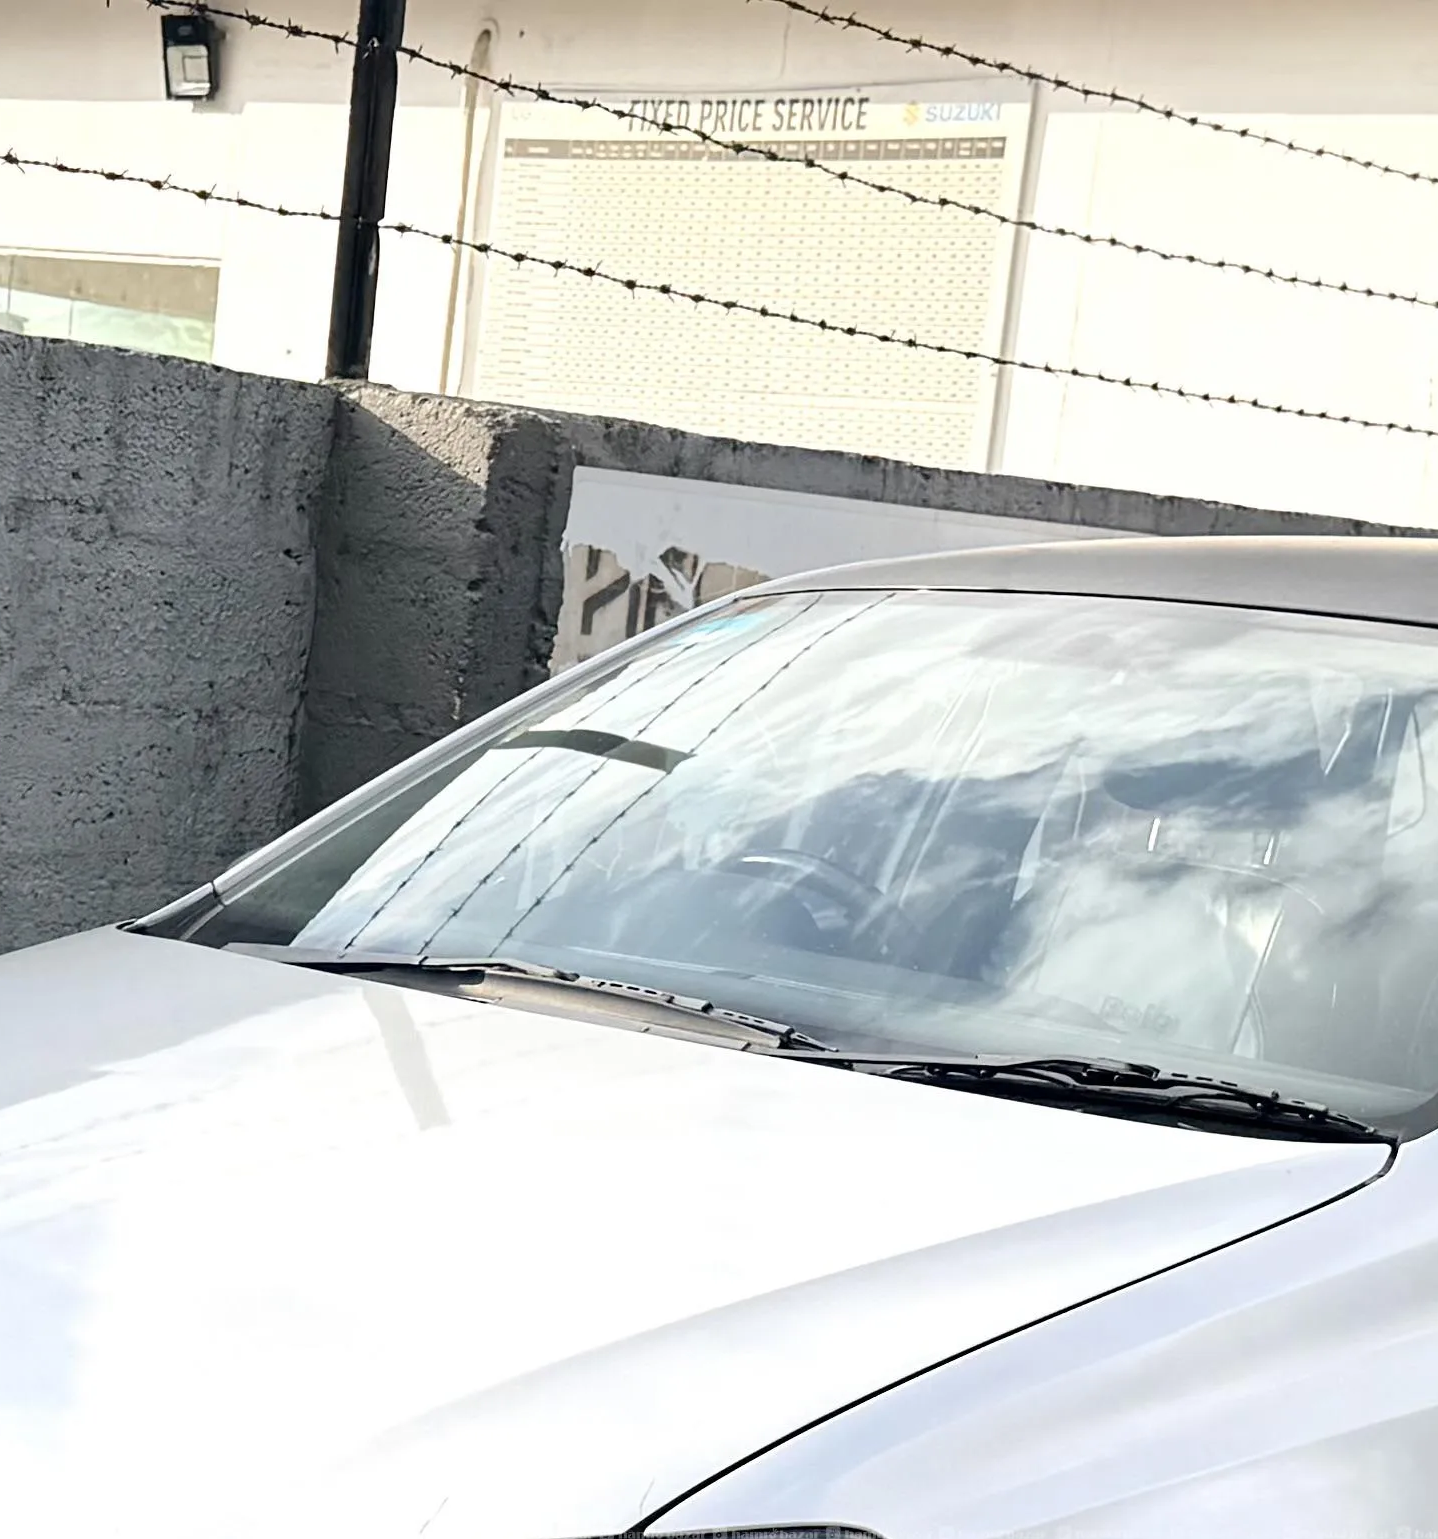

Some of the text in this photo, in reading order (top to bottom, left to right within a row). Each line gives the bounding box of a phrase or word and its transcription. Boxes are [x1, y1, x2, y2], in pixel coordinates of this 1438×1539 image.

[628, 96, 870, 133] FIXED PRICE SERVICE
[925, 102, 1003, 123] SUZUKI
